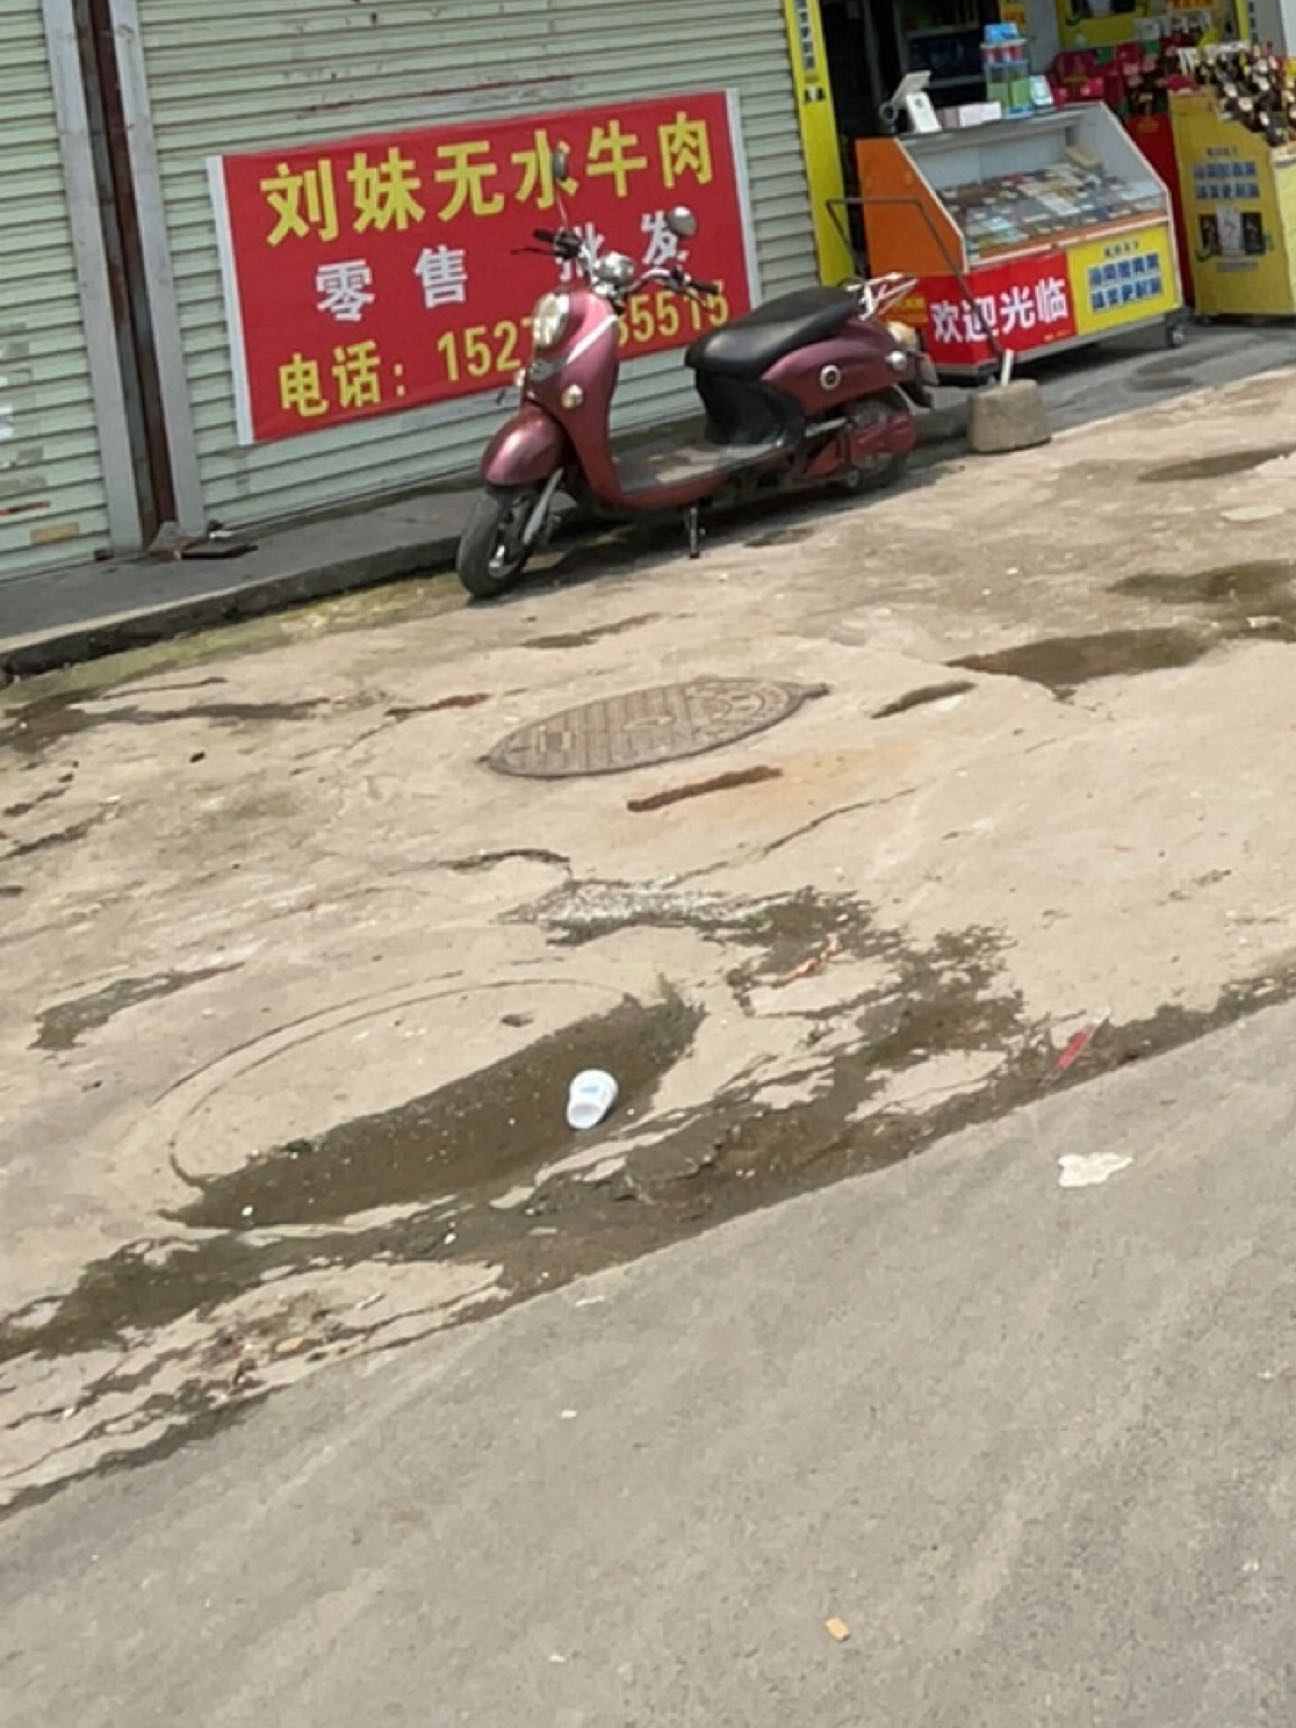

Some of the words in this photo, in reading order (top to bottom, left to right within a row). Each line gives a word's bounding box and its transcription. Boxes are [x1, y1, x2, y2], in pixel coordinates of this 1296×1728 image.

[260, 111, 713, 247] 刘妹无水牛肉
[315, 244, 469, 323] 零售
[930, 276, 1069, 344] 欢迎光临
